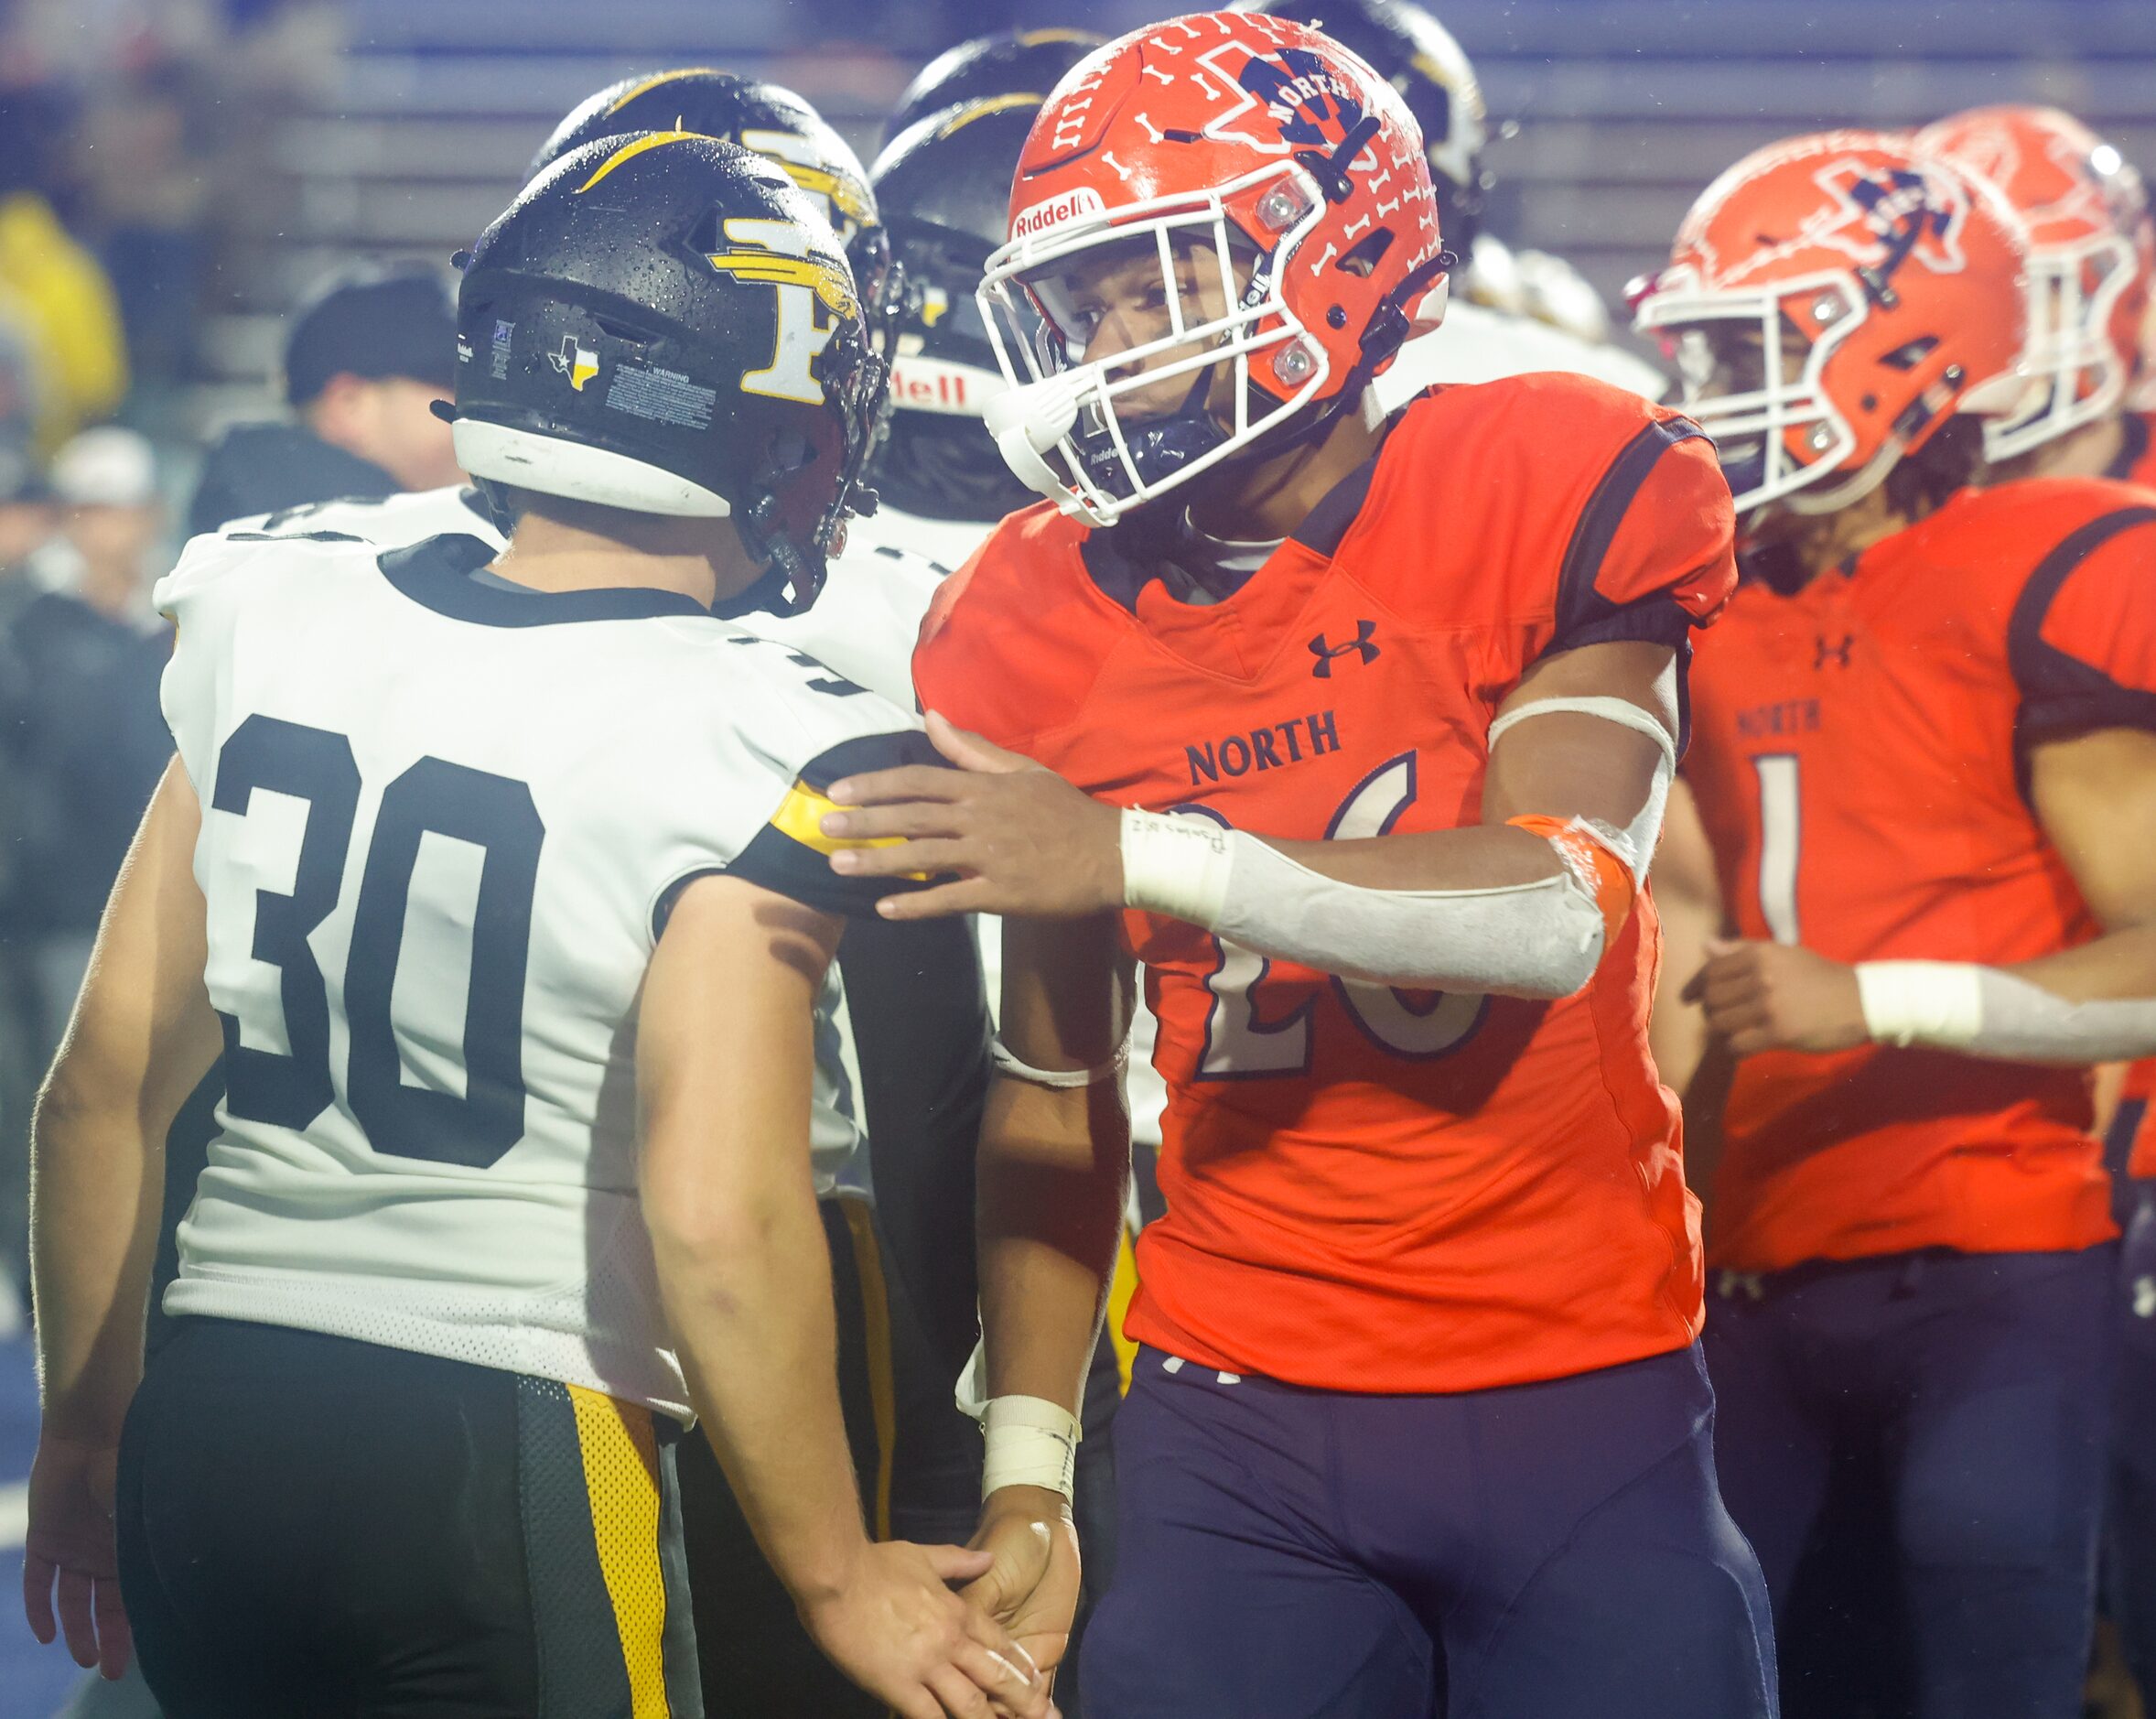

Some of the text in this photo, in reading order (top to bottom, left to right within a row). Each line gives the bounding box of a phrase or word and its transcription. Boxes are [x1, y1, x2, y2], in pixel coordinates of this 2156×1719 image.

[1267, 74, 1350, 125] NORTH
[652, 366, 690, 384] WARNING
[1185, 710, 1342, 786] NORTH
[1746, 751, 1803, 948] 1
[211, 712, 546, 1170] 30
